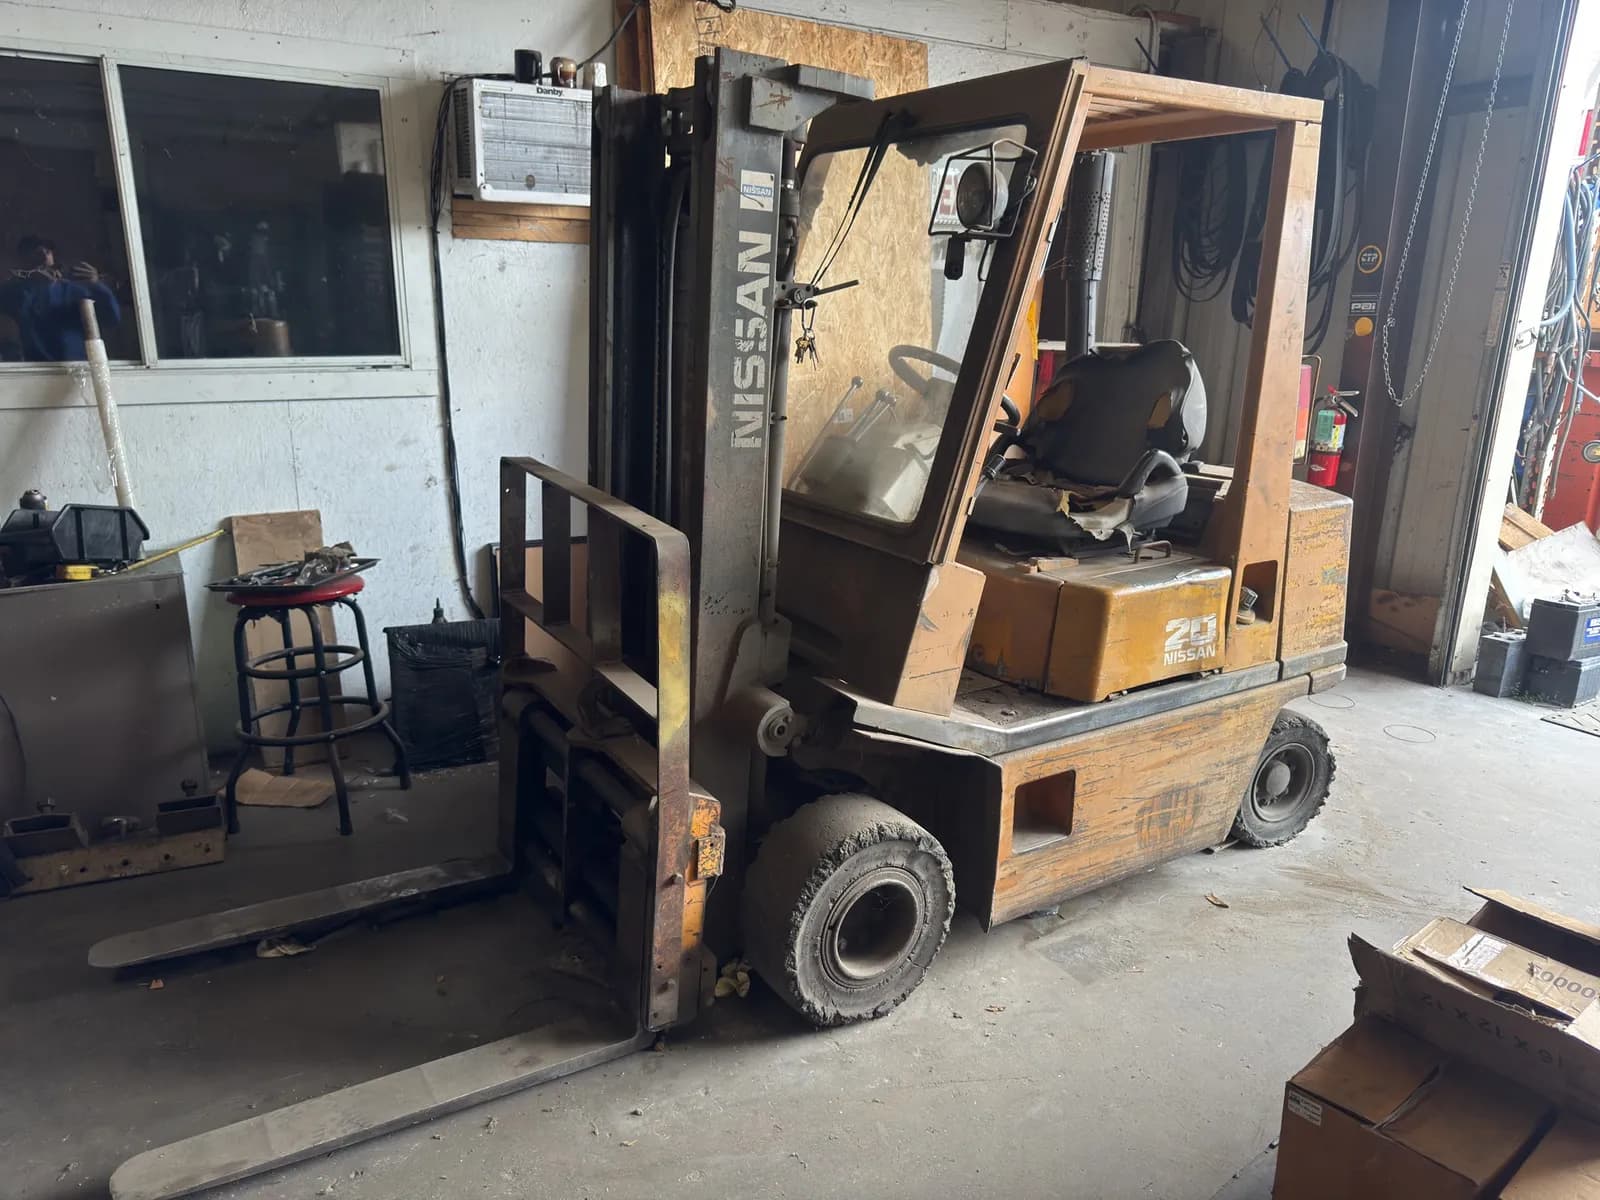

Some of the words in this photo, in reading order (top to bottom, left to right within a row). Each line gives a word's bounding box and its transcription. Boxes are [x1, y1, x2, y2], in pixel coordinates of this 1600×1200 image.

[536, 87, 563, 97] Danby
[742, 184, 773, 197] NISSAN
[730, 230, 772, 449] NISSAN
[1163, 643, 1216, 667] NISSAN
